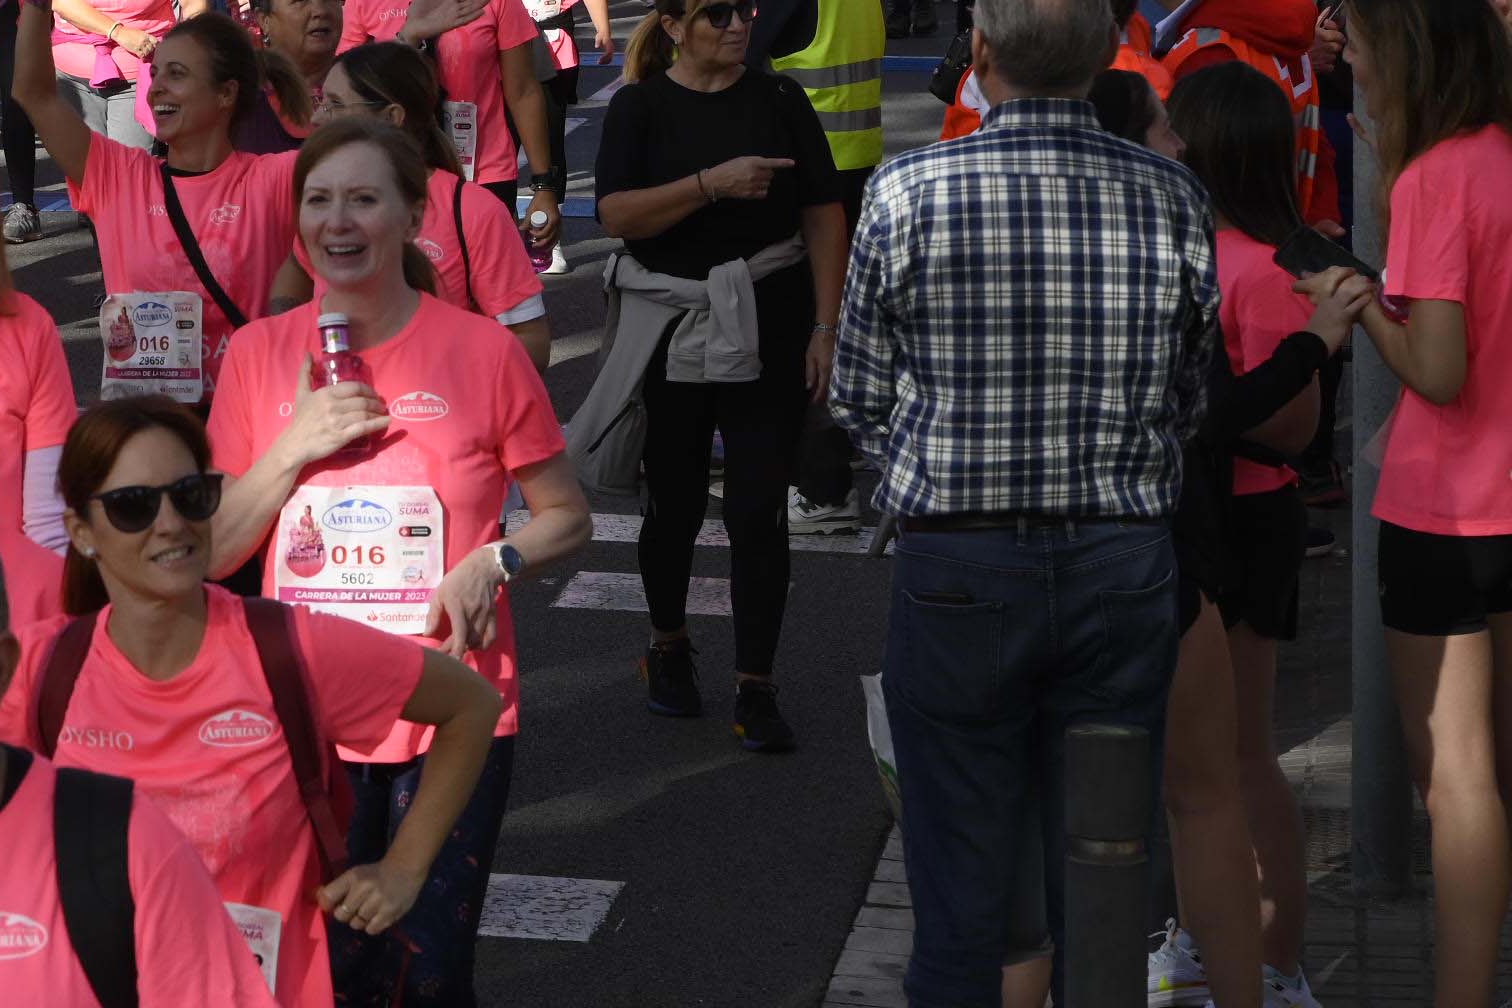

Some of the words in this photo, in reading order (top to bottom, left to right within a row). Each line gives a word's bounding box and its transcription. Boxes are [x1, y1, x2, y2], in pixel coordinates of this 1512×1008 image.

[139, 336, 169, 352] 016
[139, 356, 166, 366] 29658
[394, 402, 445, 414] ASTURIANA
[328, 510, 387, 525] ASTURIANA
[399, 507, 430, 516] SUMA
[331, 545, 385, 565] 016
[341, 572, 374, 585] 5602
[295, 591, 339, 600] CARRERA
[340, 591, 354, 600] DE
[355, 591, 368, 600] LA
[369, 591, 402, 601] MUJER
[404, 591, 426, 601] 2023
[60, 726, 134, 751] OYSHO
[207, 723, 272, 740] ASTURIANA
